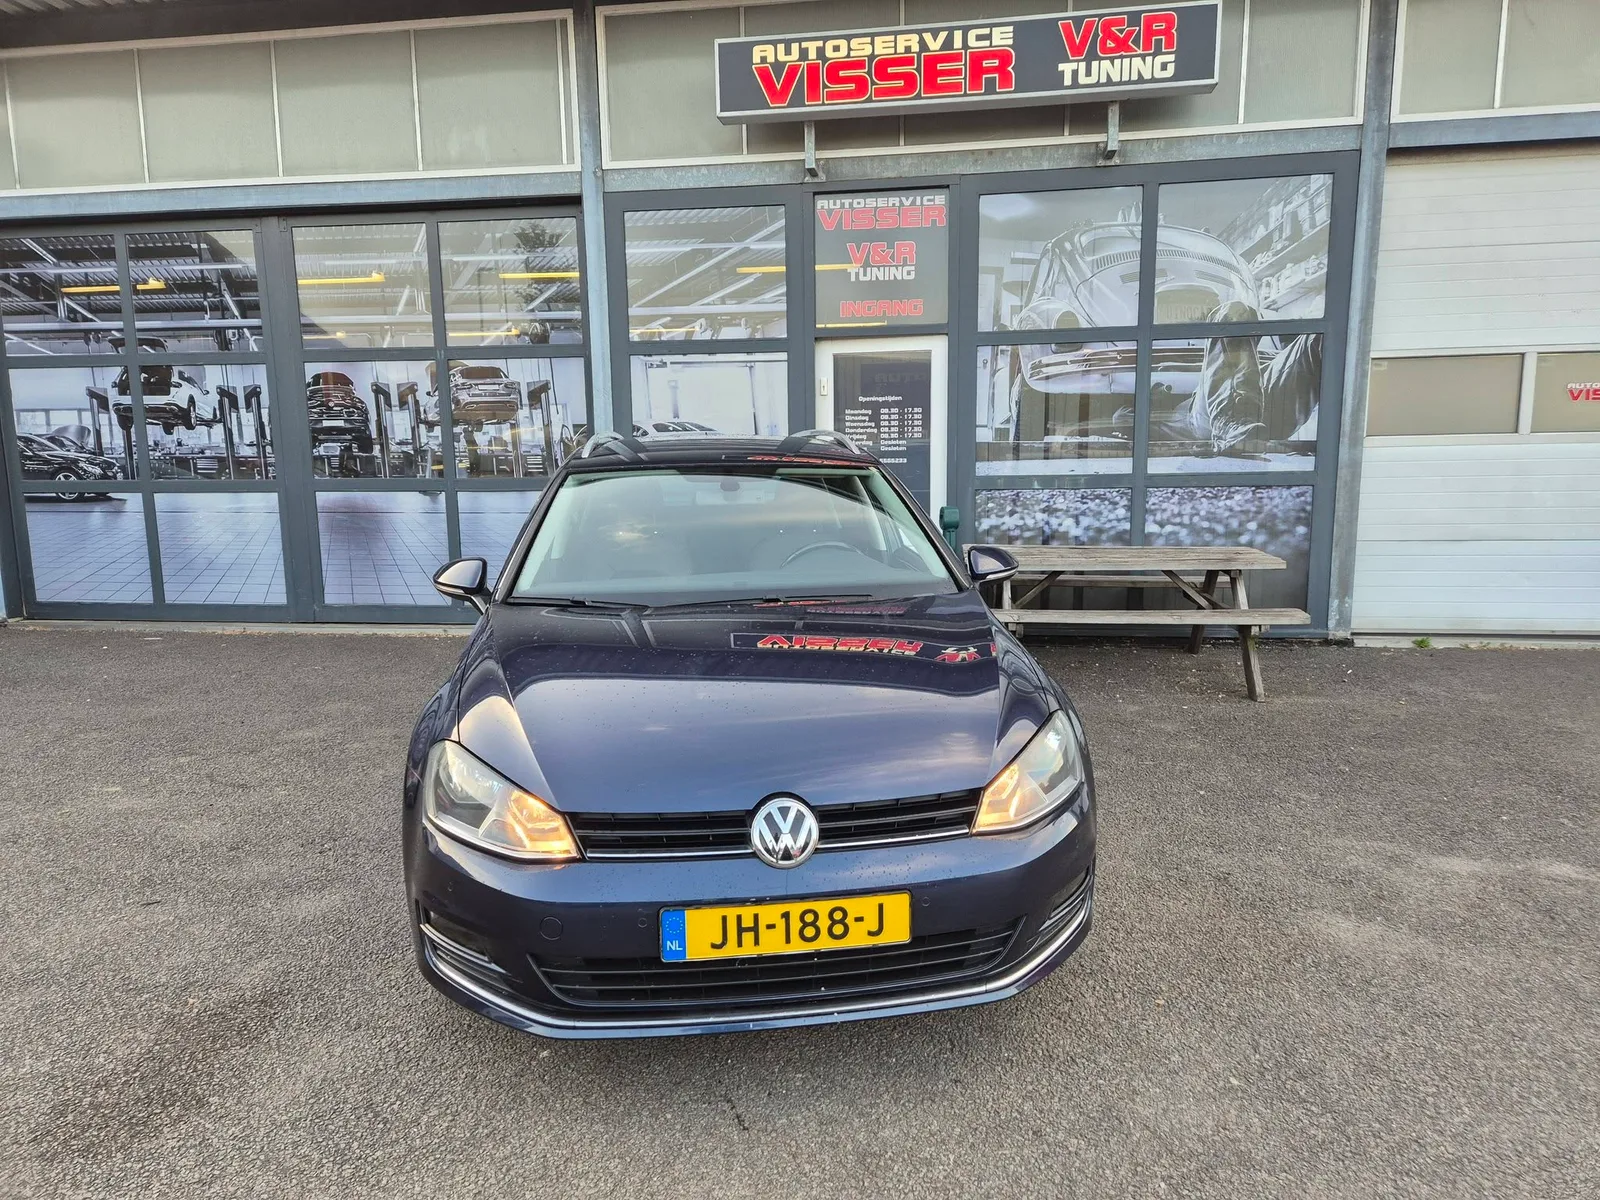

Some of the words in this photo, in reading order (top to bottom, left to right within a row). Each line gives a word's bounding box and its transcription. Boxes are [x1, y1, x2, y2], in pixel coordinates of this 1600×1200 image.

[753, 26, 1014, 64] AUTOSERVICE
[1058, 12, 1177, 59] V&R
[752, 47, 1016, 107] VISSER
[1058, 54, 1175, 86] TUNING
[817, 195, 945, 209] AUTOSERVICE
[817, 205, 947, 231] VISSER
[847, 241, 916, 266] V&R
[847, 266, 915, 281] TUNING
[840, 299, 924, 317] INGANG
[710, 903, 884, 950] JH-188-J
[666, 940, 683, 951] NL
